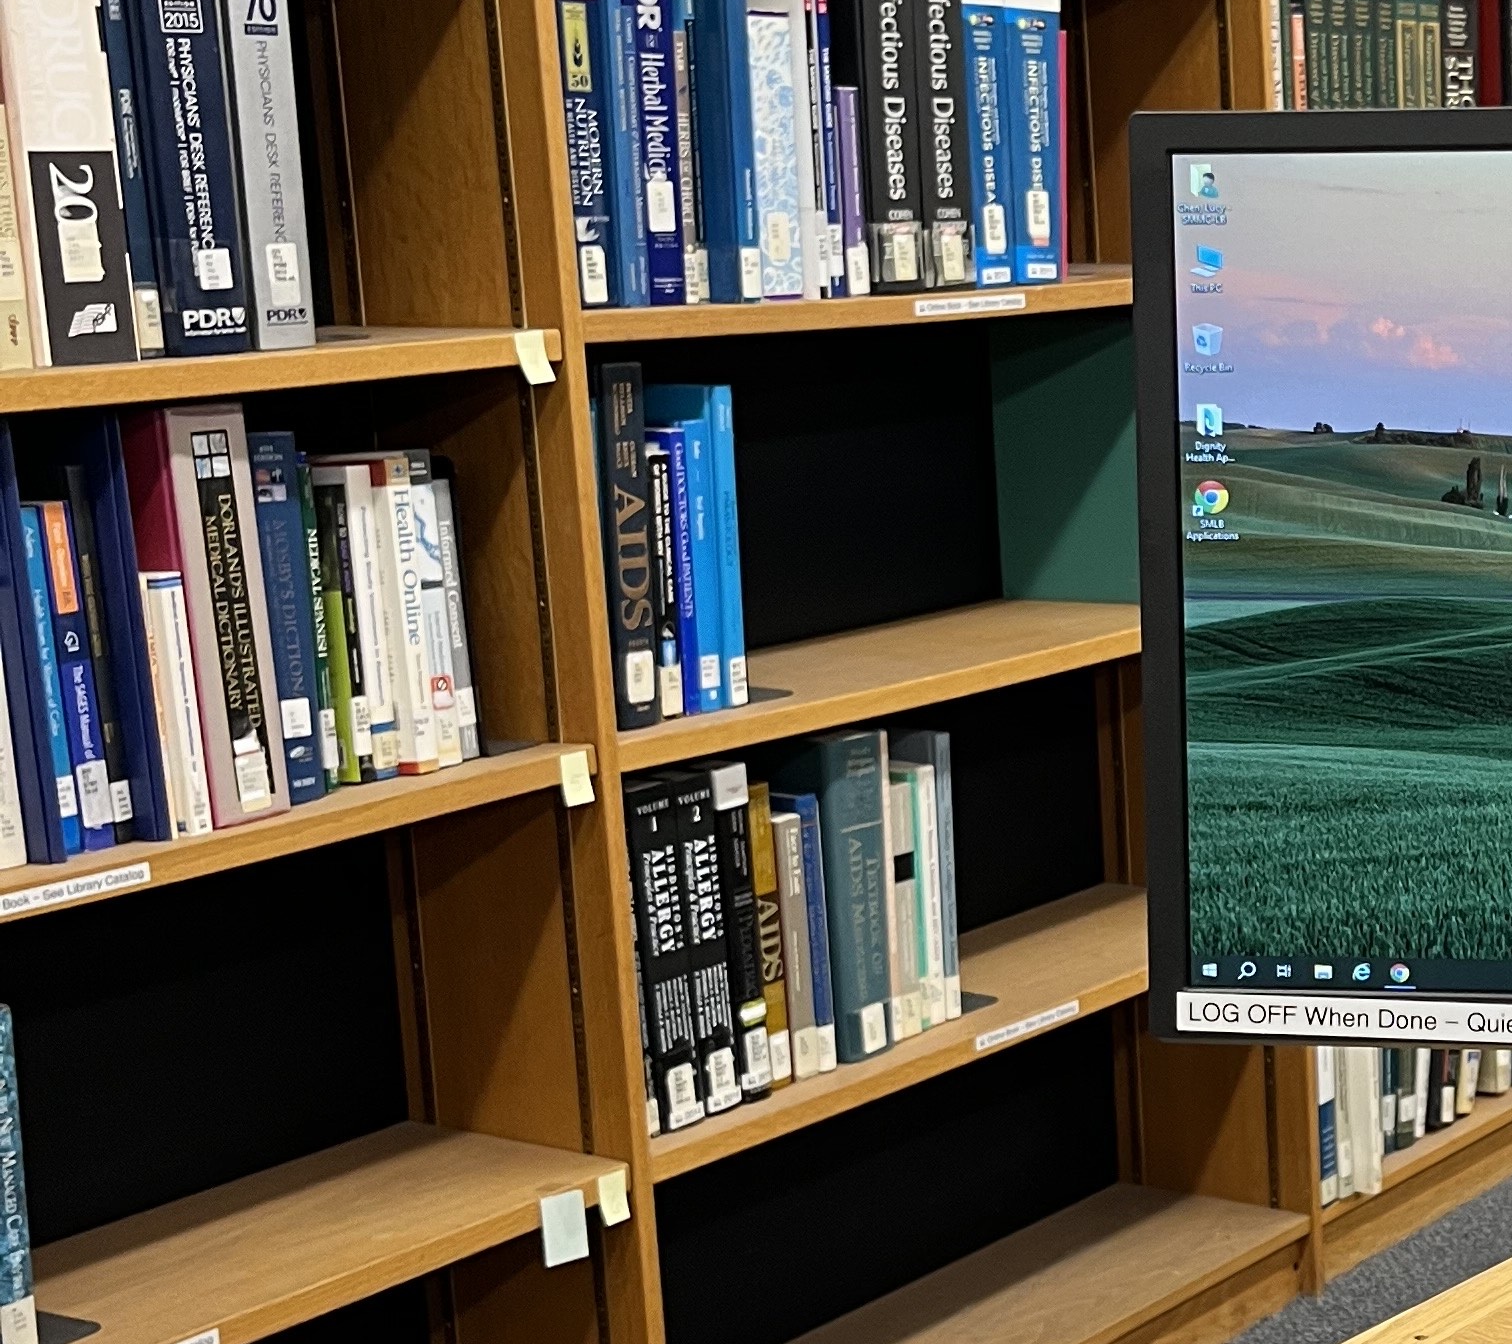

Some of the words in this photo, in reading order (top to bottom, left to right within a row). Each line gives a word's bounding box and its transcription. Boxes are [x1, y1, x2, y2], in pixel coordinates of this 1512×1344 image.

[164, 11, 200, 29] 2015
[176, 37, 200, 127] PHYSICIANS'
[188, 132, 203, 169] DESK
[570, 73, 590, 90] 50
[641, 52, 670, 115] Herbal
[976, 56, 994, 150] INFECTIOUS
[574, 97, 594, 207] NUTRITION
[585, 109, 604, 194] MODERN
[883, 95, 907, 201] Diseases
[930, 96, 954, 199] Diseases
[182, 309, 232, 331] PDR
[1191, 283, 1208, 292] This
[1209, 283, 1223, 293] PC
[1184, 362, 1215, 373] Recycle
[1217, 362, 1233, 372] Bin
[1186, 452, 1214, 462] Health
[1195, 440, 1226, 453] Dignity
[204, 515, 227, 599] MEDICAL
[392, 489, 413, 561] Health
[438, 519, 458, 586] Informed
[613, 483, 655, 632] AIDS
[1186, 530, 1239, 541] Applications
[306, 528, 322, 594] MEDICAL
[217, 492, 245, 598] DORLAND'S
[231, 602, 262, 729] ILLUSTRATED
[313, 597, 328, 659] SPANISH
[400, 568, 421, 646] Online
[447, 590, 463, 649] Consent
[215, 603, 242, 712] DICTIONARY
[636, 798, 670, 816] VOLUME
[651, 817, 658, 832] 1
[677, 789, 711, 806] VOLUME
[693, 806, 701, 823] 2
[651, 850, 677, 952] ALLERGY
[665, 844, 685, 950] MIDDLETON'S
[693, 839, 717, 940] ALLERGY
[707, 835, 725, 937] MIDDLETON'S
[757, 898, 785, 982] AIDS
[1188, 1001, 1240, 1024] LOG
[1247, 1003, 1298, 1025] OFF
[1304, 1006, 1369, 1029] When
[1379, 1009, 1437, 1031] Done
